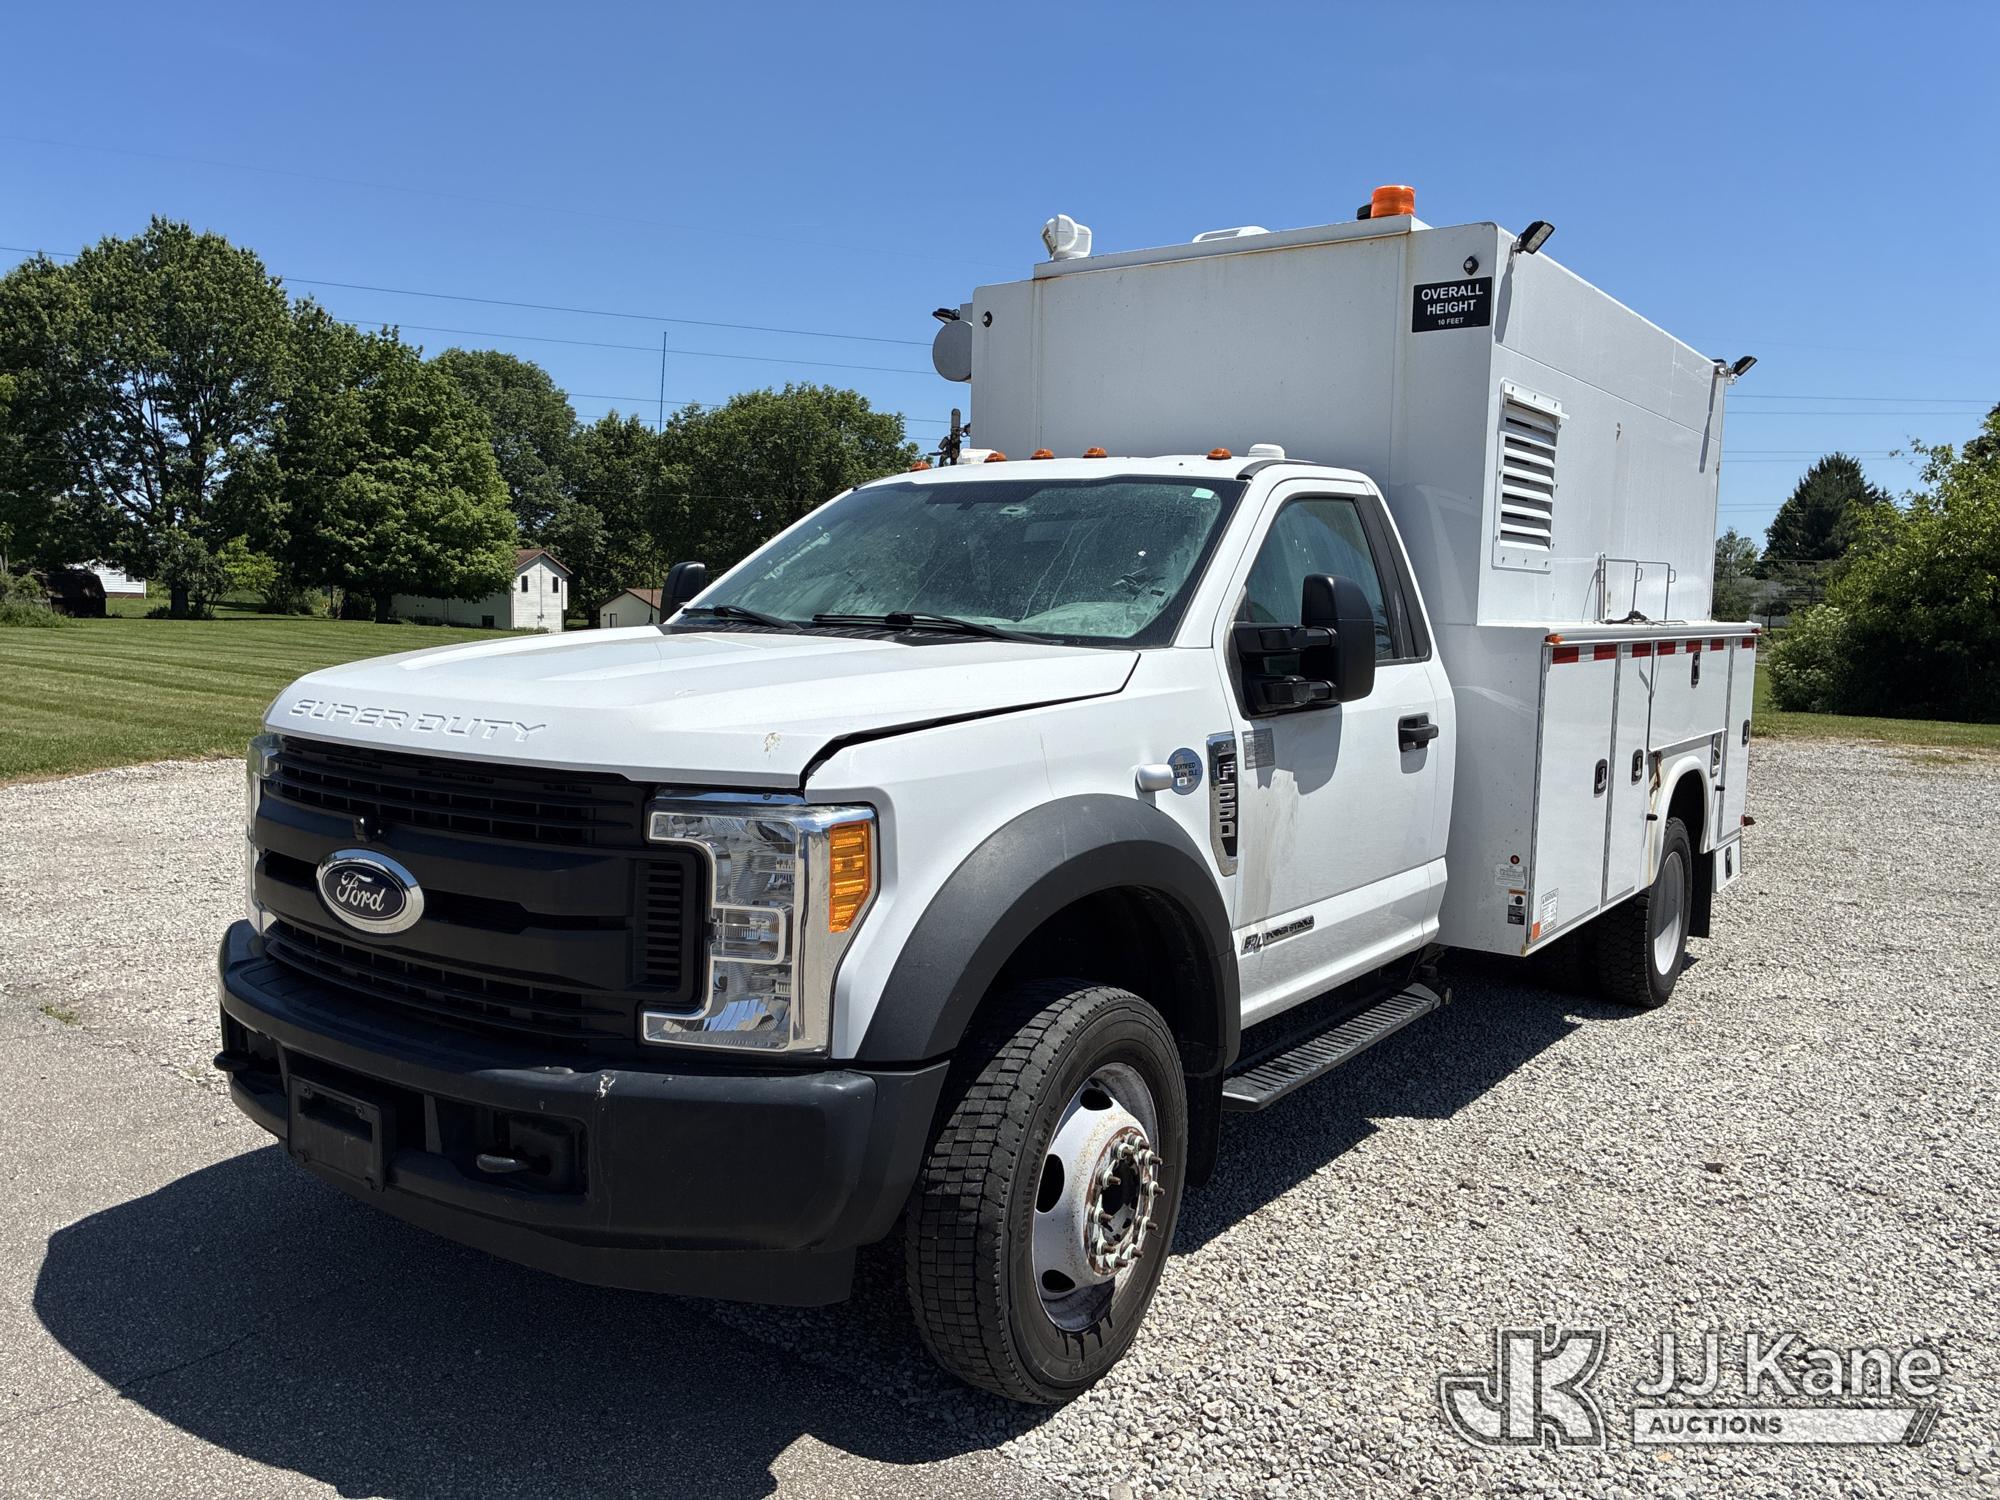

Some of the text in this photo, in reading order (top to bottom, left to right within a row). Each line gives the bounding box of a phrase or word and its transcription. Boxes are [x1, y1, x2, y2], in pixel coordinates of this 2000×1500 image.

[1421, 283, 1484, 301] OVERALL
[1426, 299, 1477, 316] HEIGHT
[1446, 316, 1464, 325] FEET
[289, 698, 548, 742] SUPER DUTY
[336, 870, 385, 912] Ford
